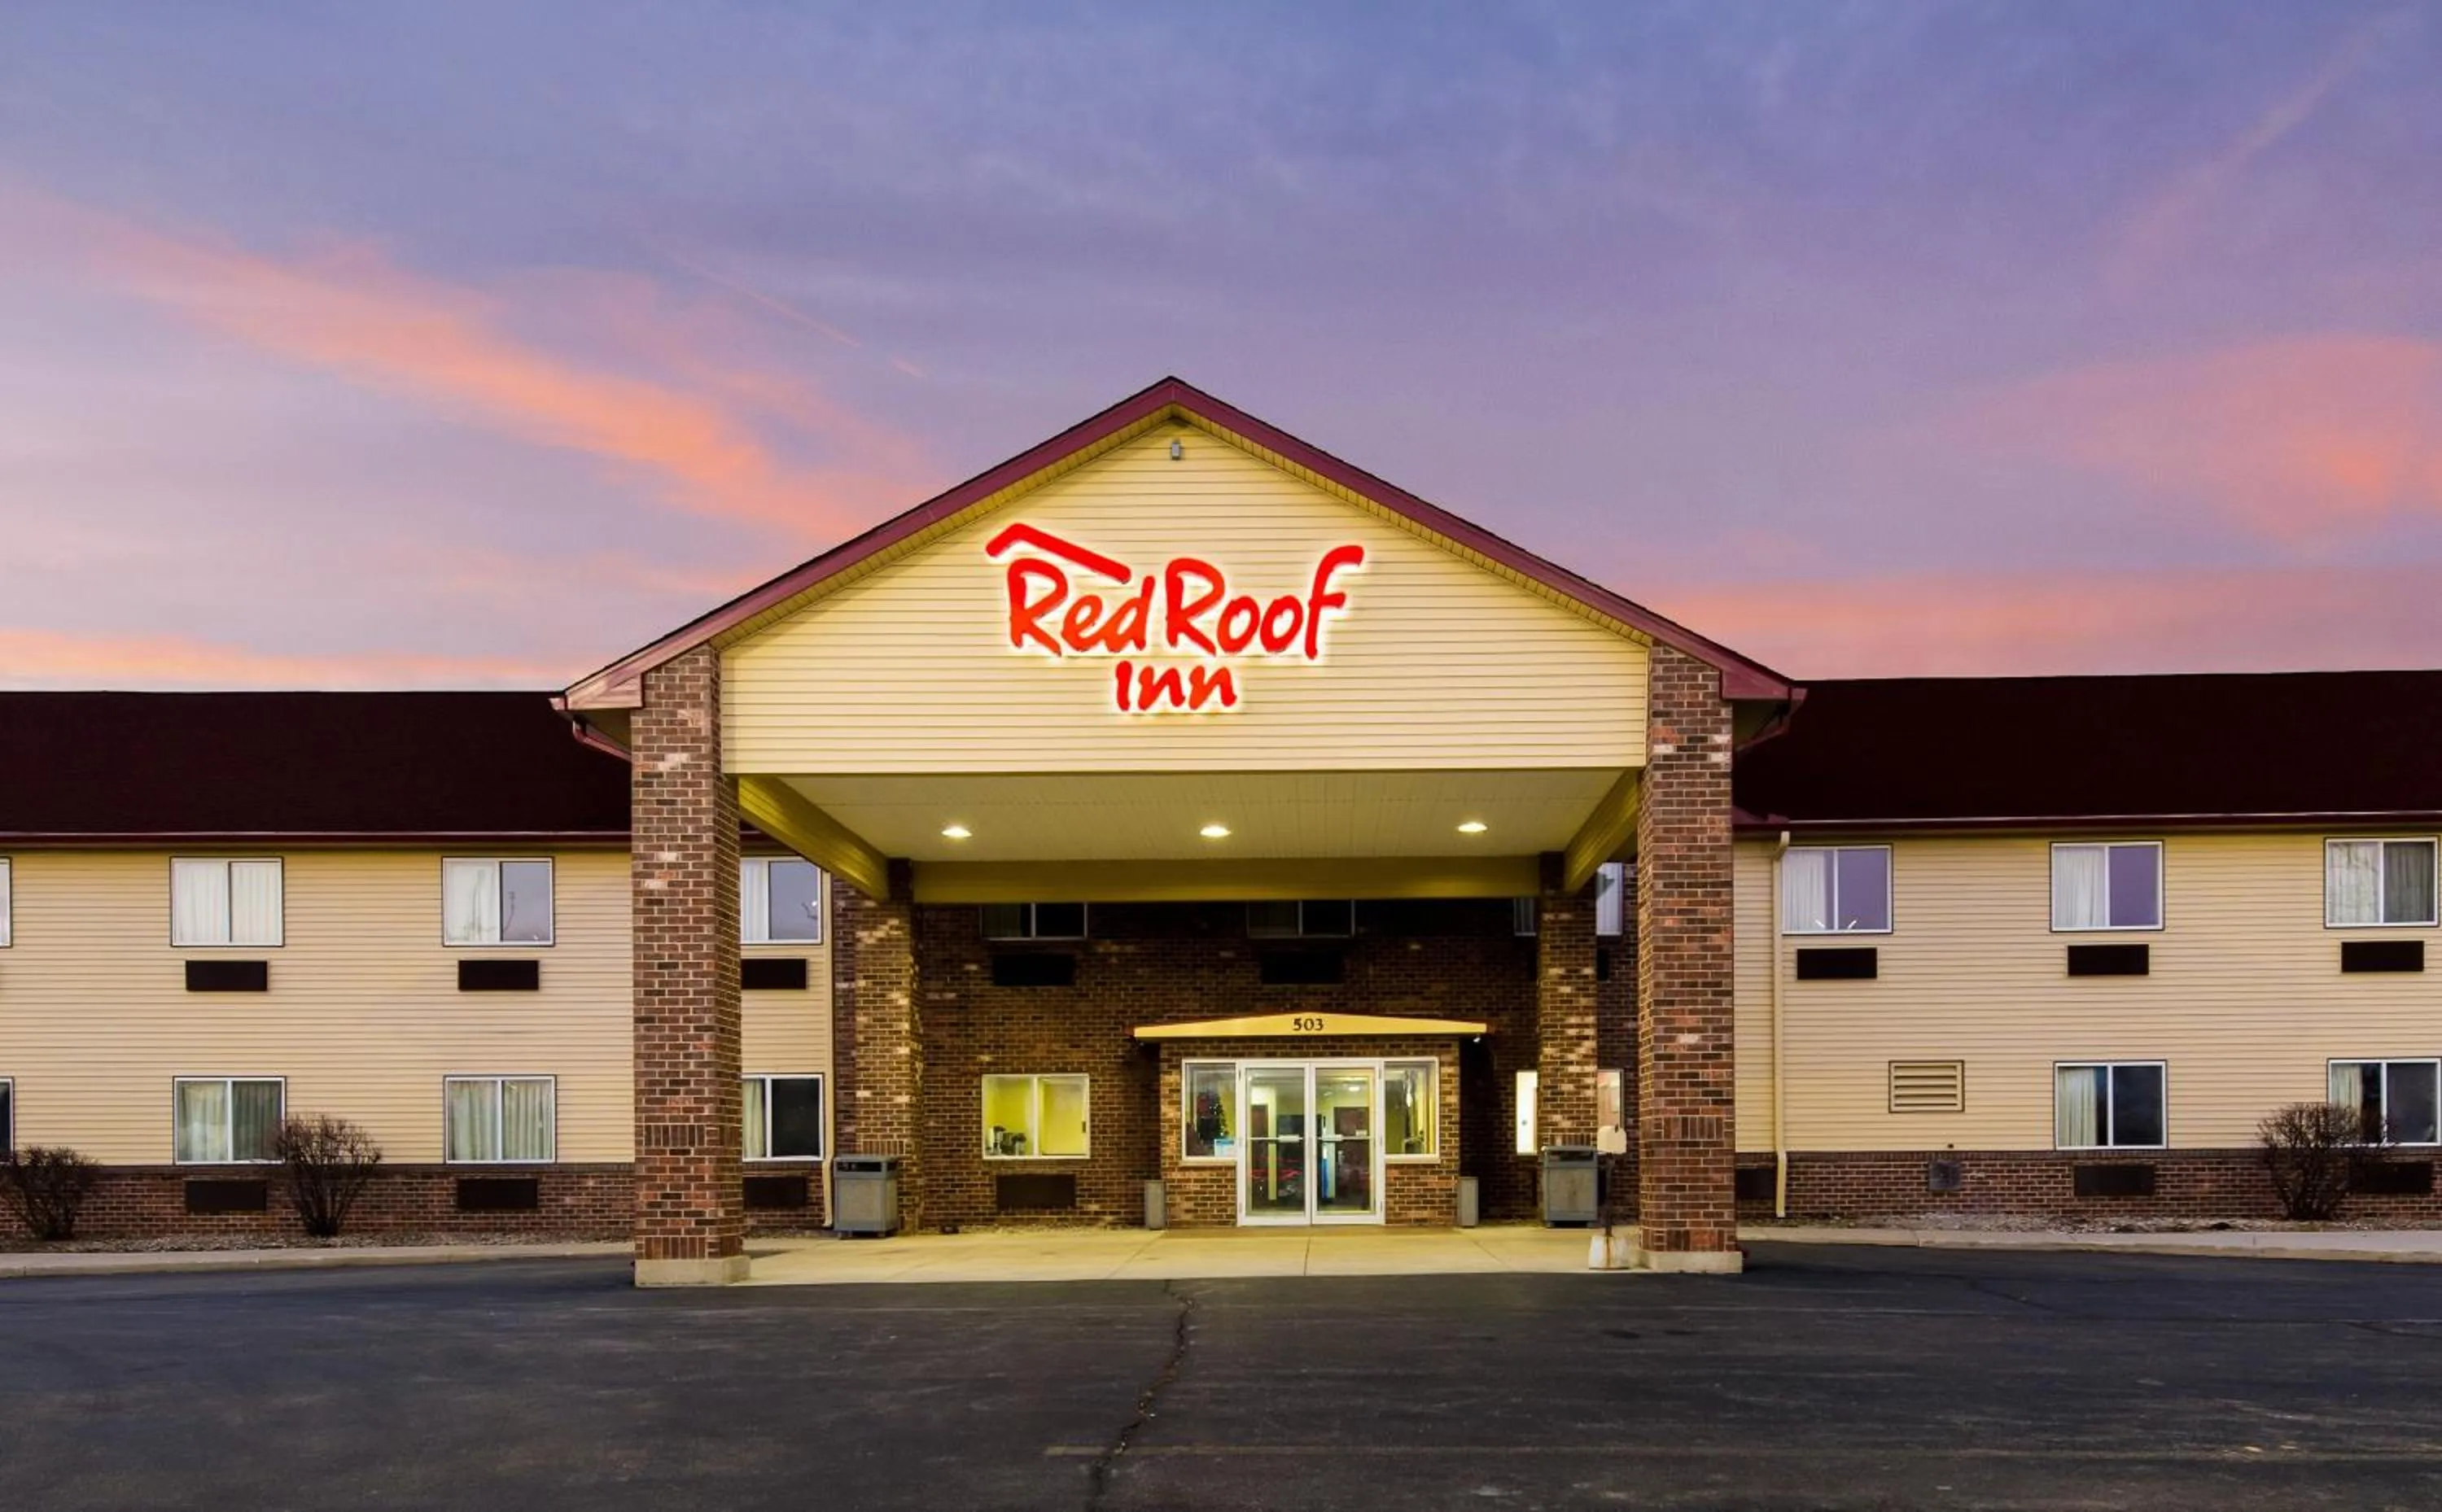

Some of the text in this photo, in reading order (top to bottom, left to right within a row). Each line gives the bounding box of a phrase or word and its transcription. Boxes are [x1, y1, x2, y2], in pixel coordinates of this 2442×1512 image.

[1008, 545, 1363, 660] Red Roof
[1115, 661, 1236, 710] Inn
[1292, 1017, 1324, 1031] 503
